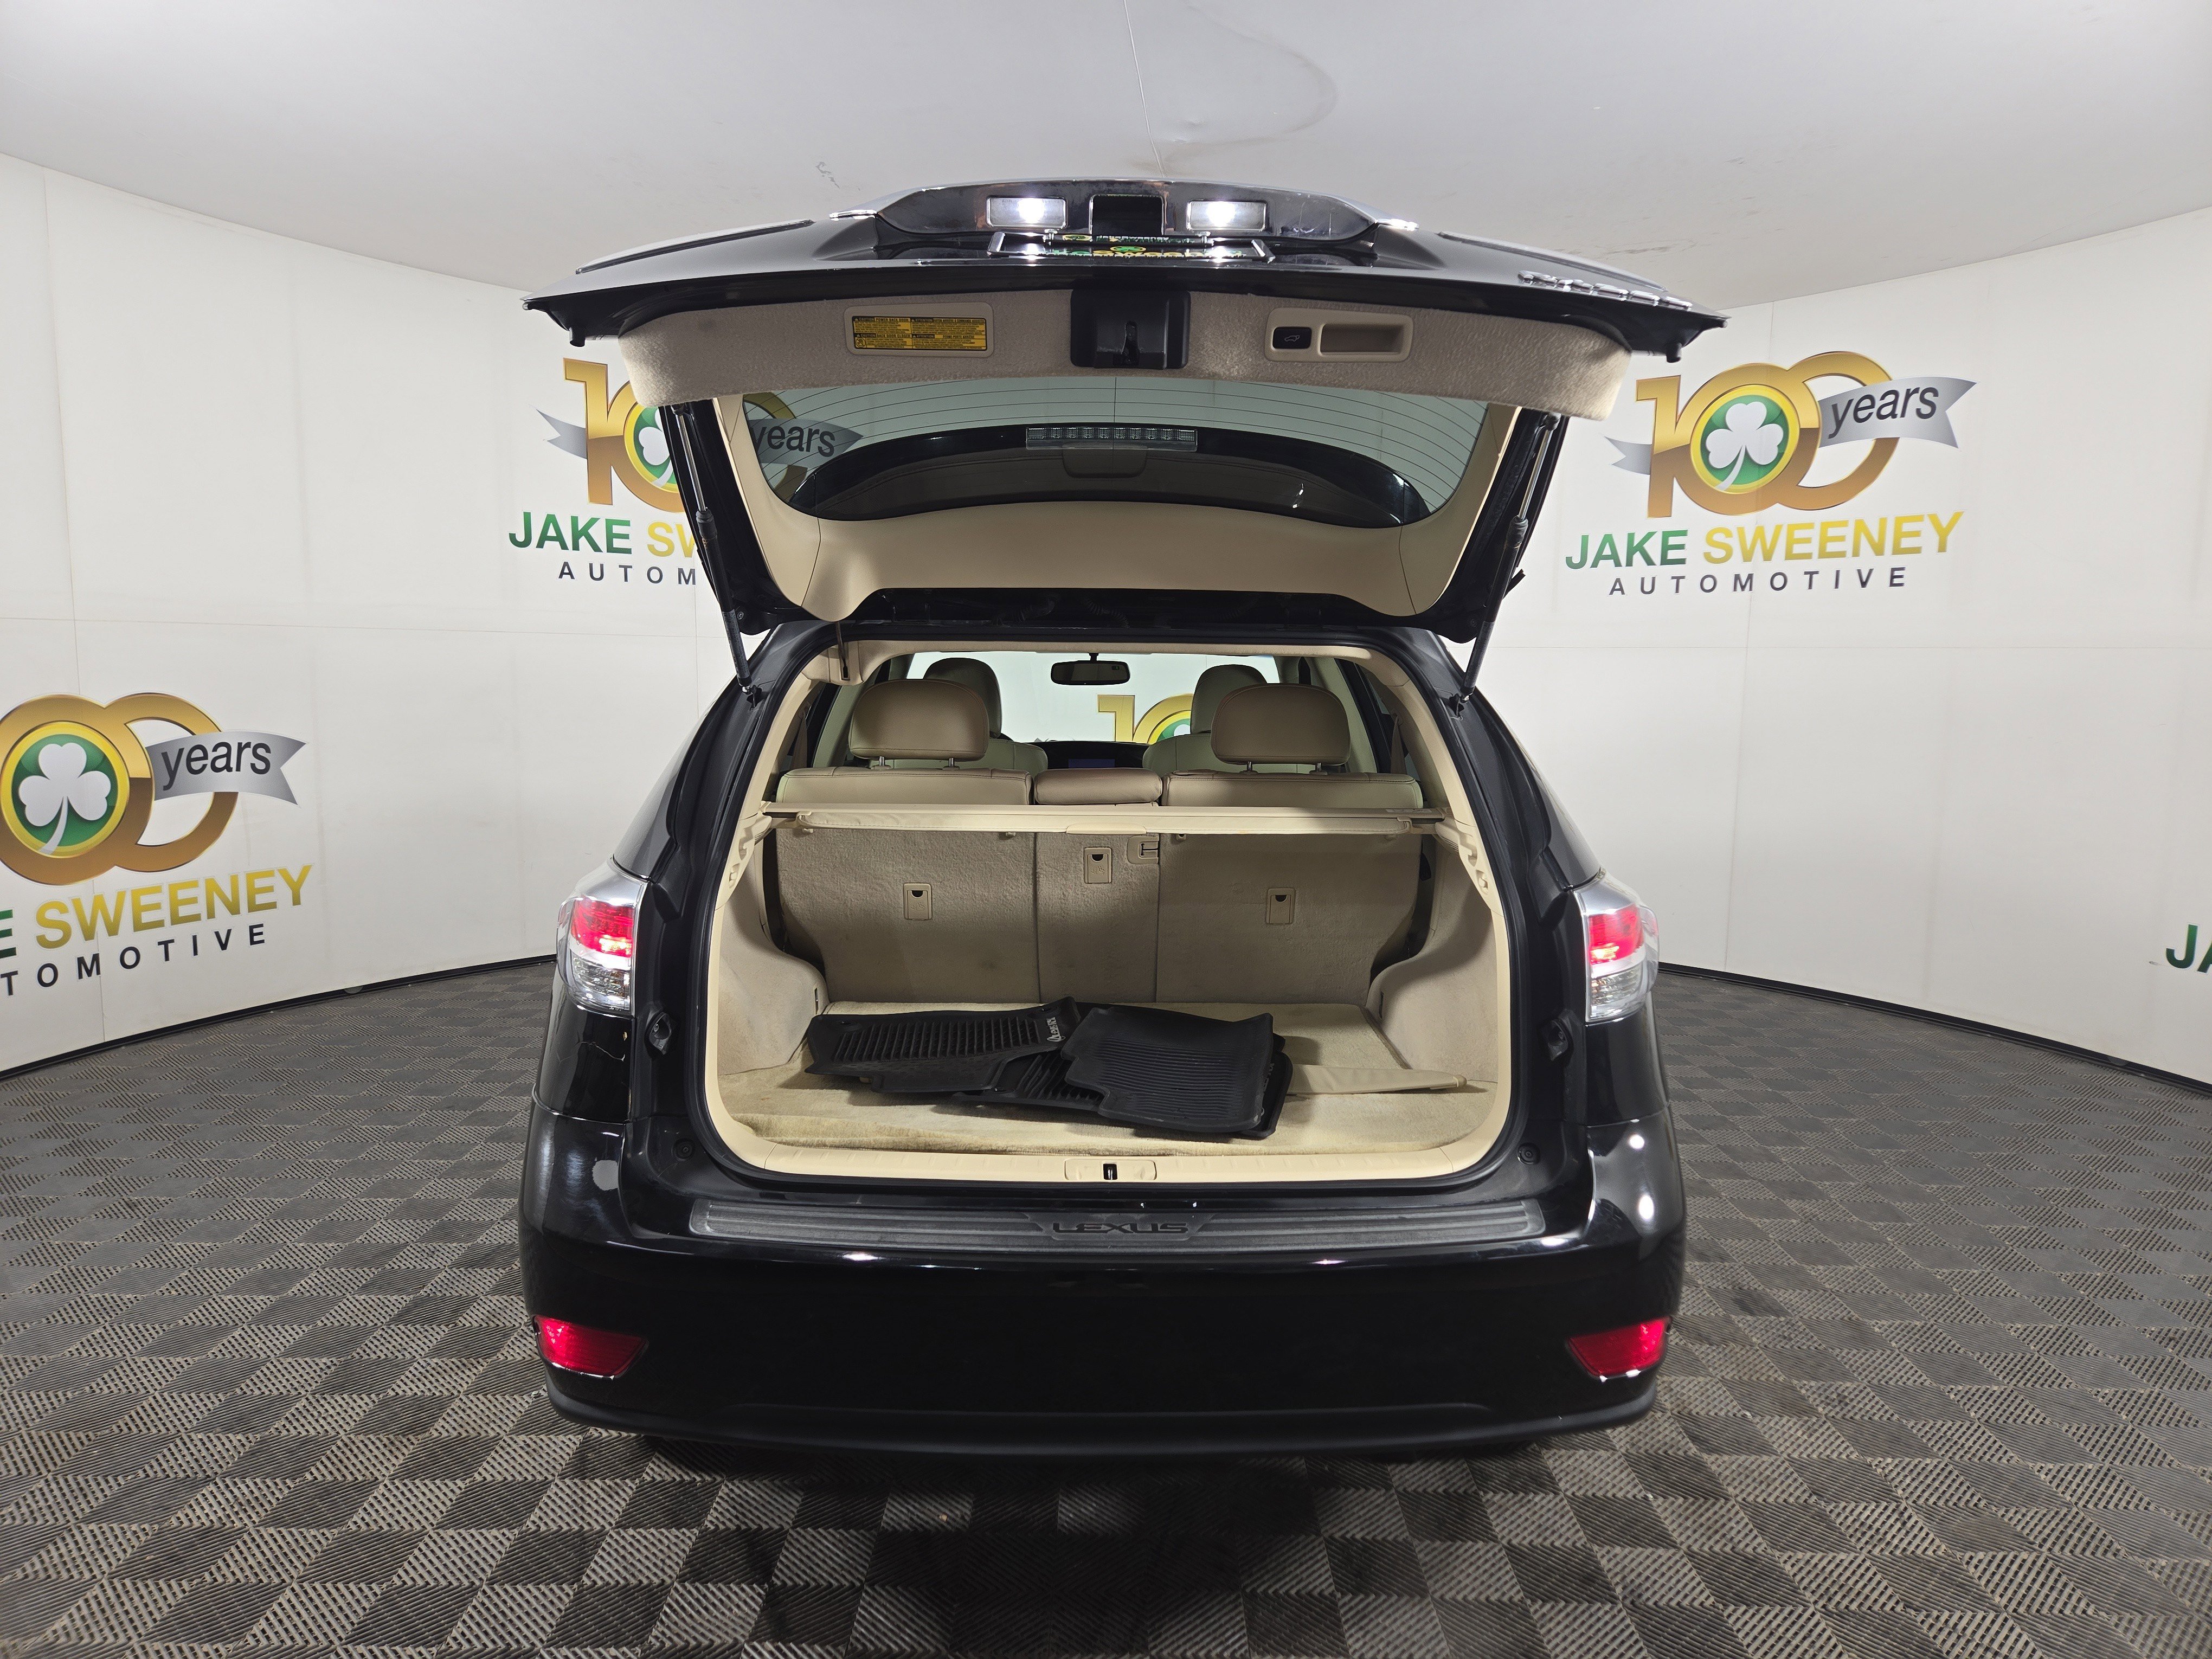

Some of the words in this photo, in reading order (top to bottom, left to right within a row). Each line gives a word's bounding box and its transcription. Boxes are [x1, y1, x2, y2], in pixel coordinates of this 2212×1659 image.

[1829, 386, 1938, 439] years
[509, 511, 632, 555] JAKE
[1565, 529, 1688, 570] JAKE
[1703, 511, 1964, 564] SWEENEY
[1609, 567, 1906, 595] AUTOMOTIVE
[162, 741, 272, 791] years
[35, 865, 312, 949] SWEENEY
[1052, 1222, 1189, 1234] LEXUS
